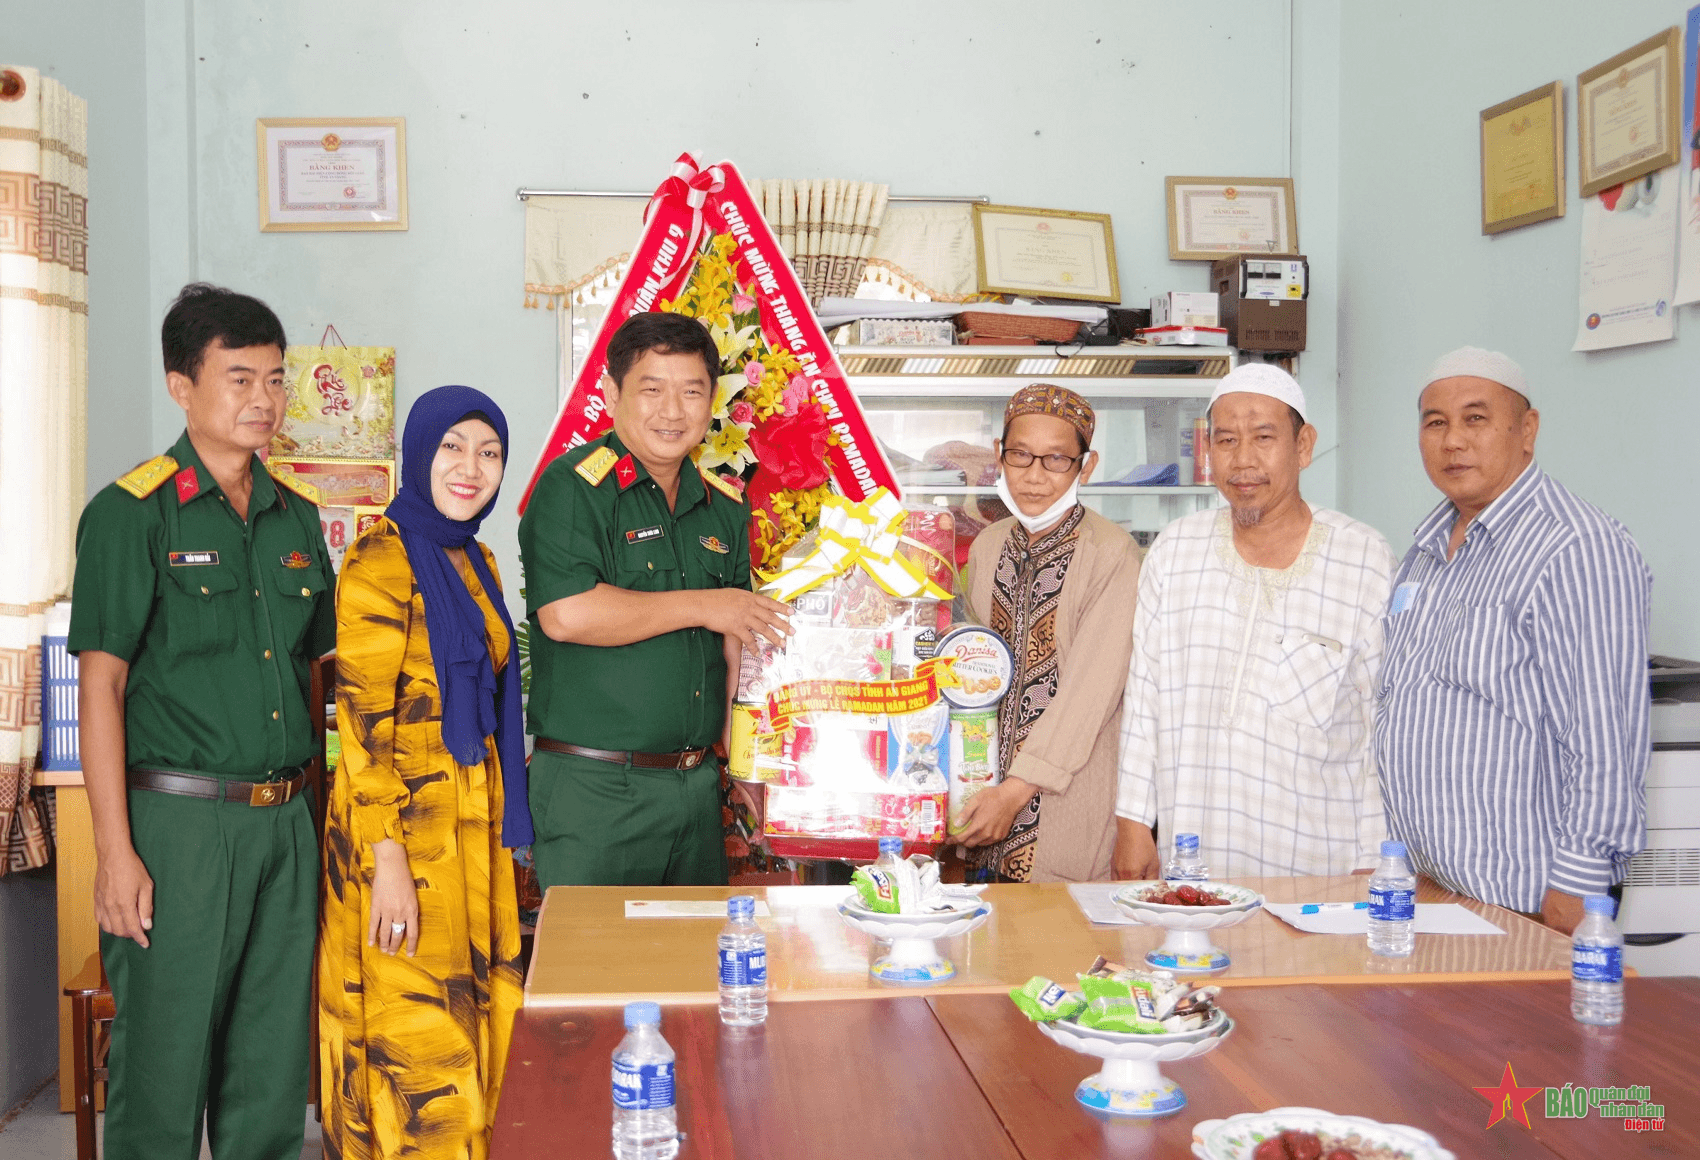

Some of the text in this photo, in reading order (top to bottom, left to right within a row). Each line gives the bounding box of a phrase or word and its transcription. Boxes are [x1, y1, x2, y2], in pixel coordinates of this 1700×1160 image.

[628, 276, 661, 318] UÂN
[651, 237, 679, 279] KHU
[668, 223, 685, 239] 9
[720, 201, 755, 247] CHÚC
[744, 247, 780, 295] MỪNG
[770, 294, 807, 352] THÁNG
[955, 644, 998, 661] Danisa
[886, 685, 899, 698] AN
[900, 680, 929, 698] GIANG
[843, 699, 885, 713] RAMADAN
[886, 698, 907, 712] NĂM
[908, 694, 928, 710] 2021
